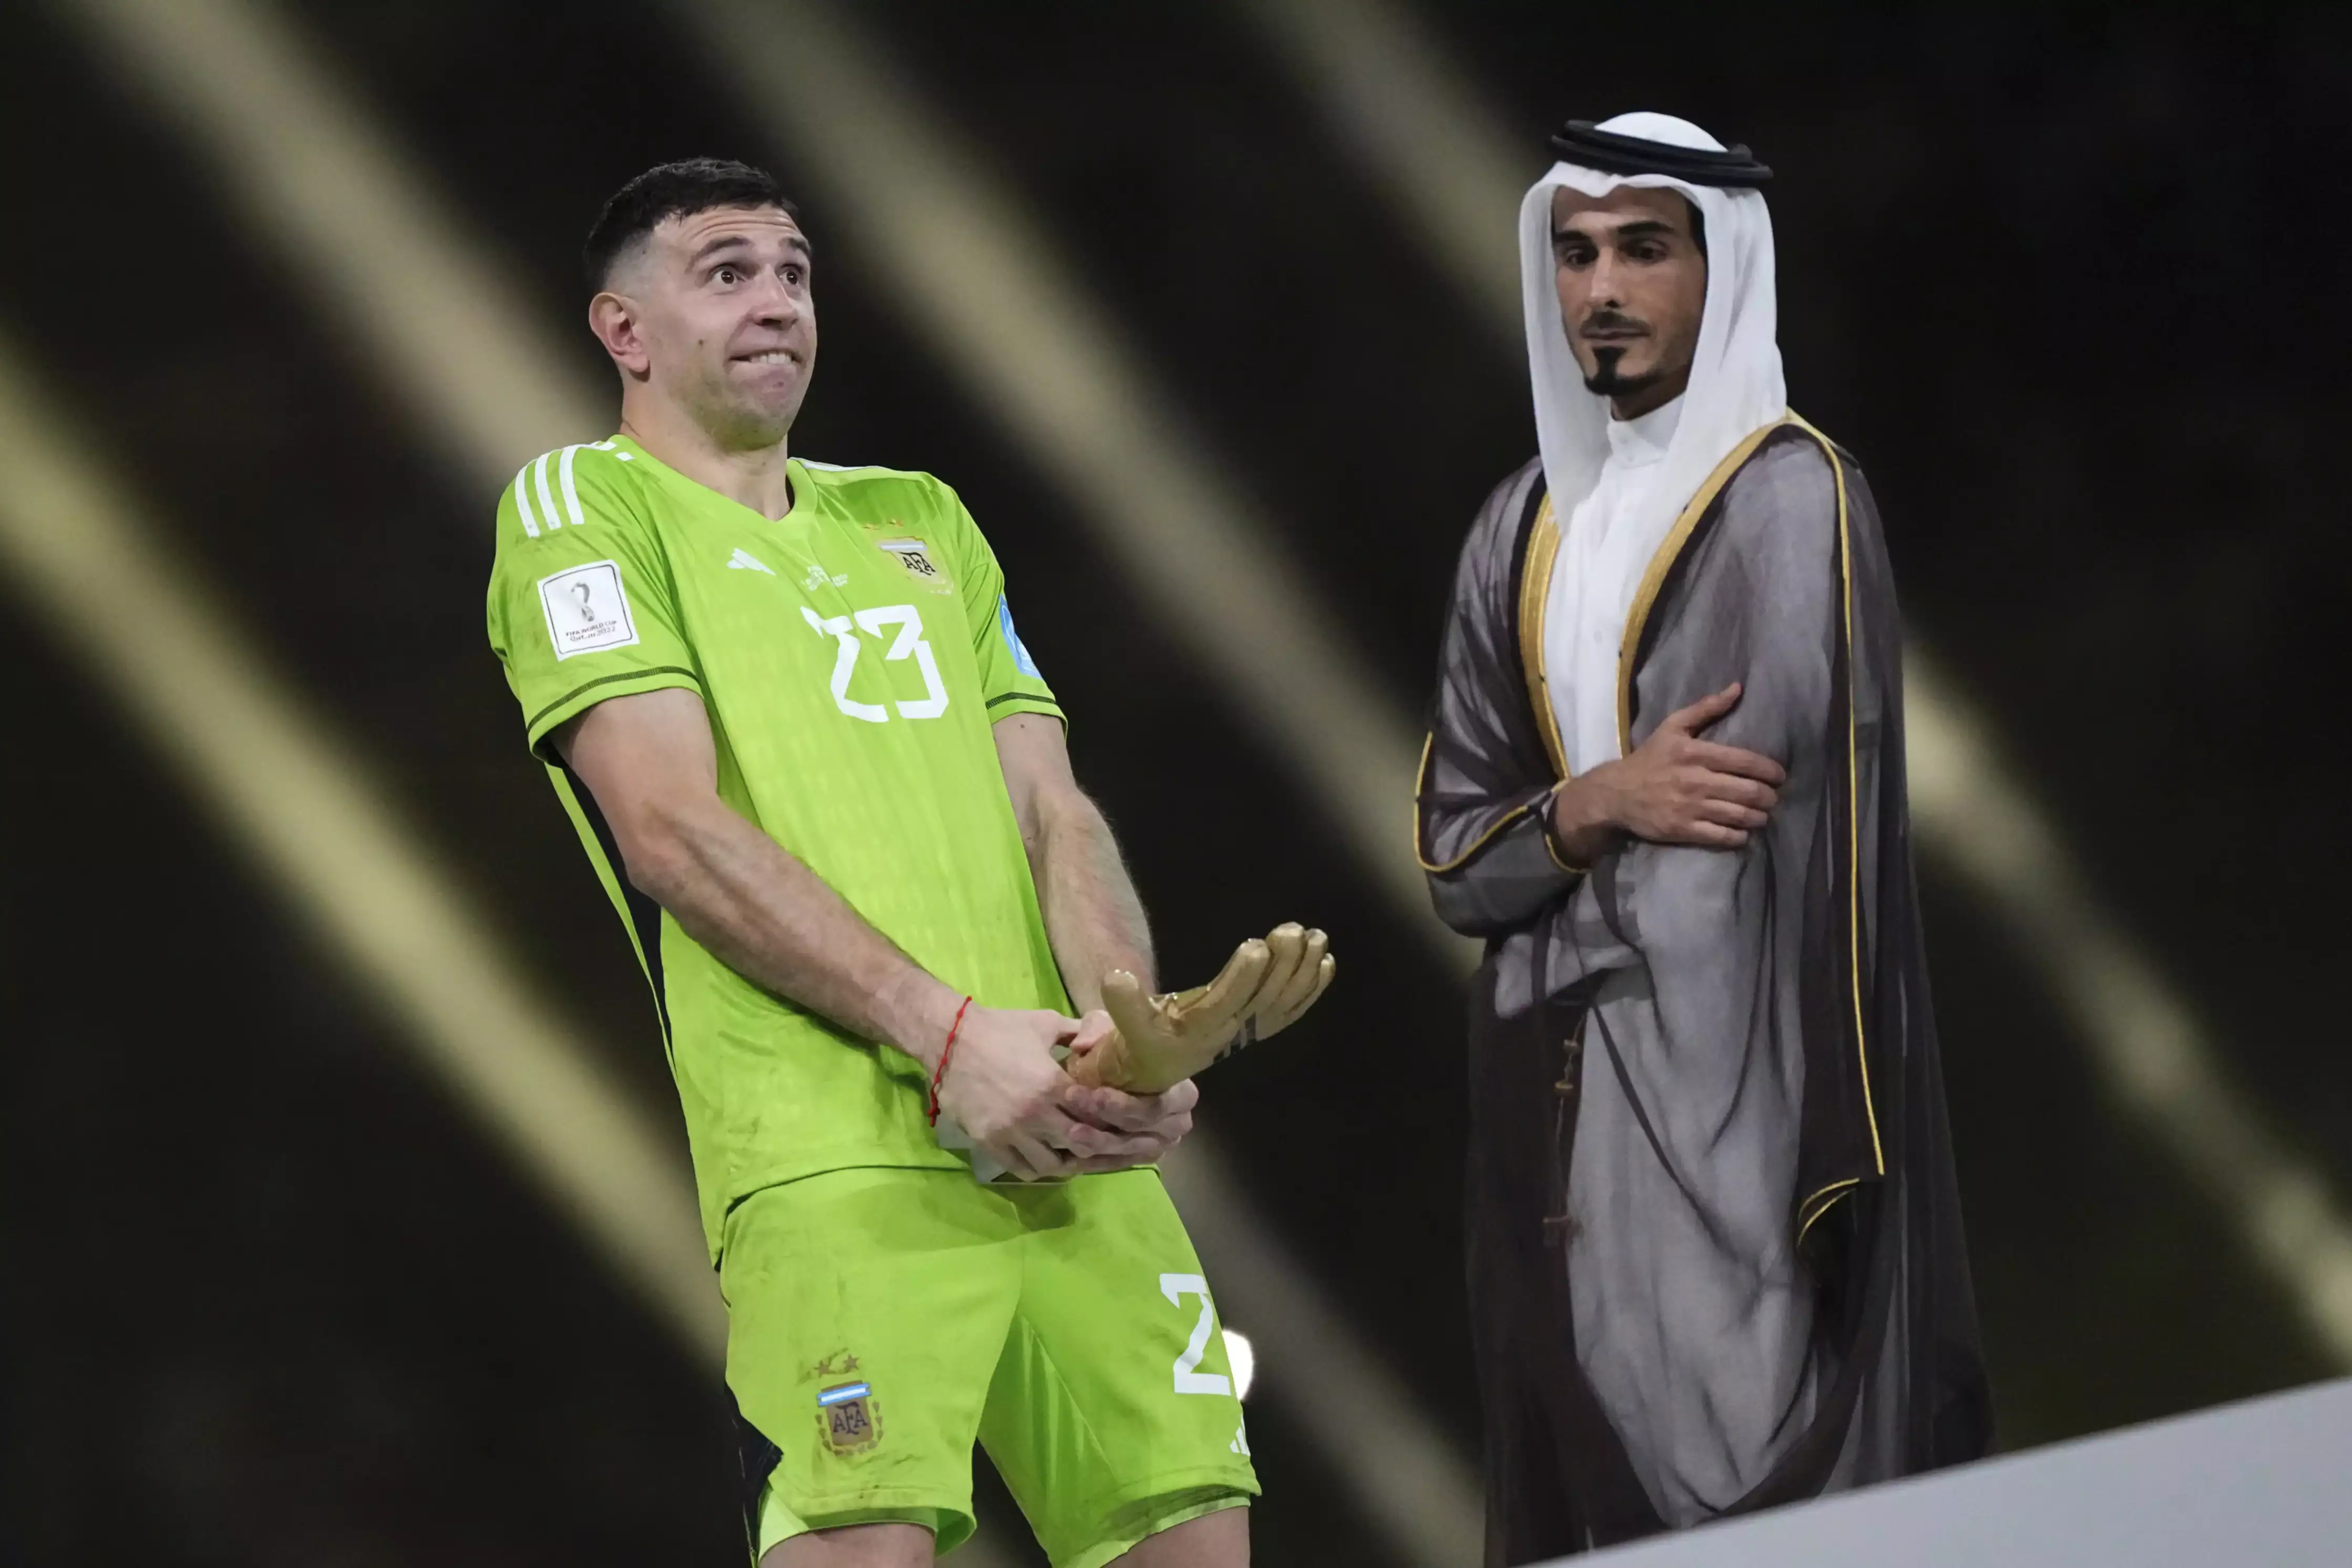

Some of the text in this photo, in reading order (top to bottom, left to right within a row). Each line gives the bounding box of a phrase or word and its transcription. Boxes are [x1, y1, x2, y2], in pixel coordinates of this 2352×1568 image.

[896, 552, 936, 576] AFA
[799, 604, 949, 723] 23
[833, 1401, 868, 1435] AFA
